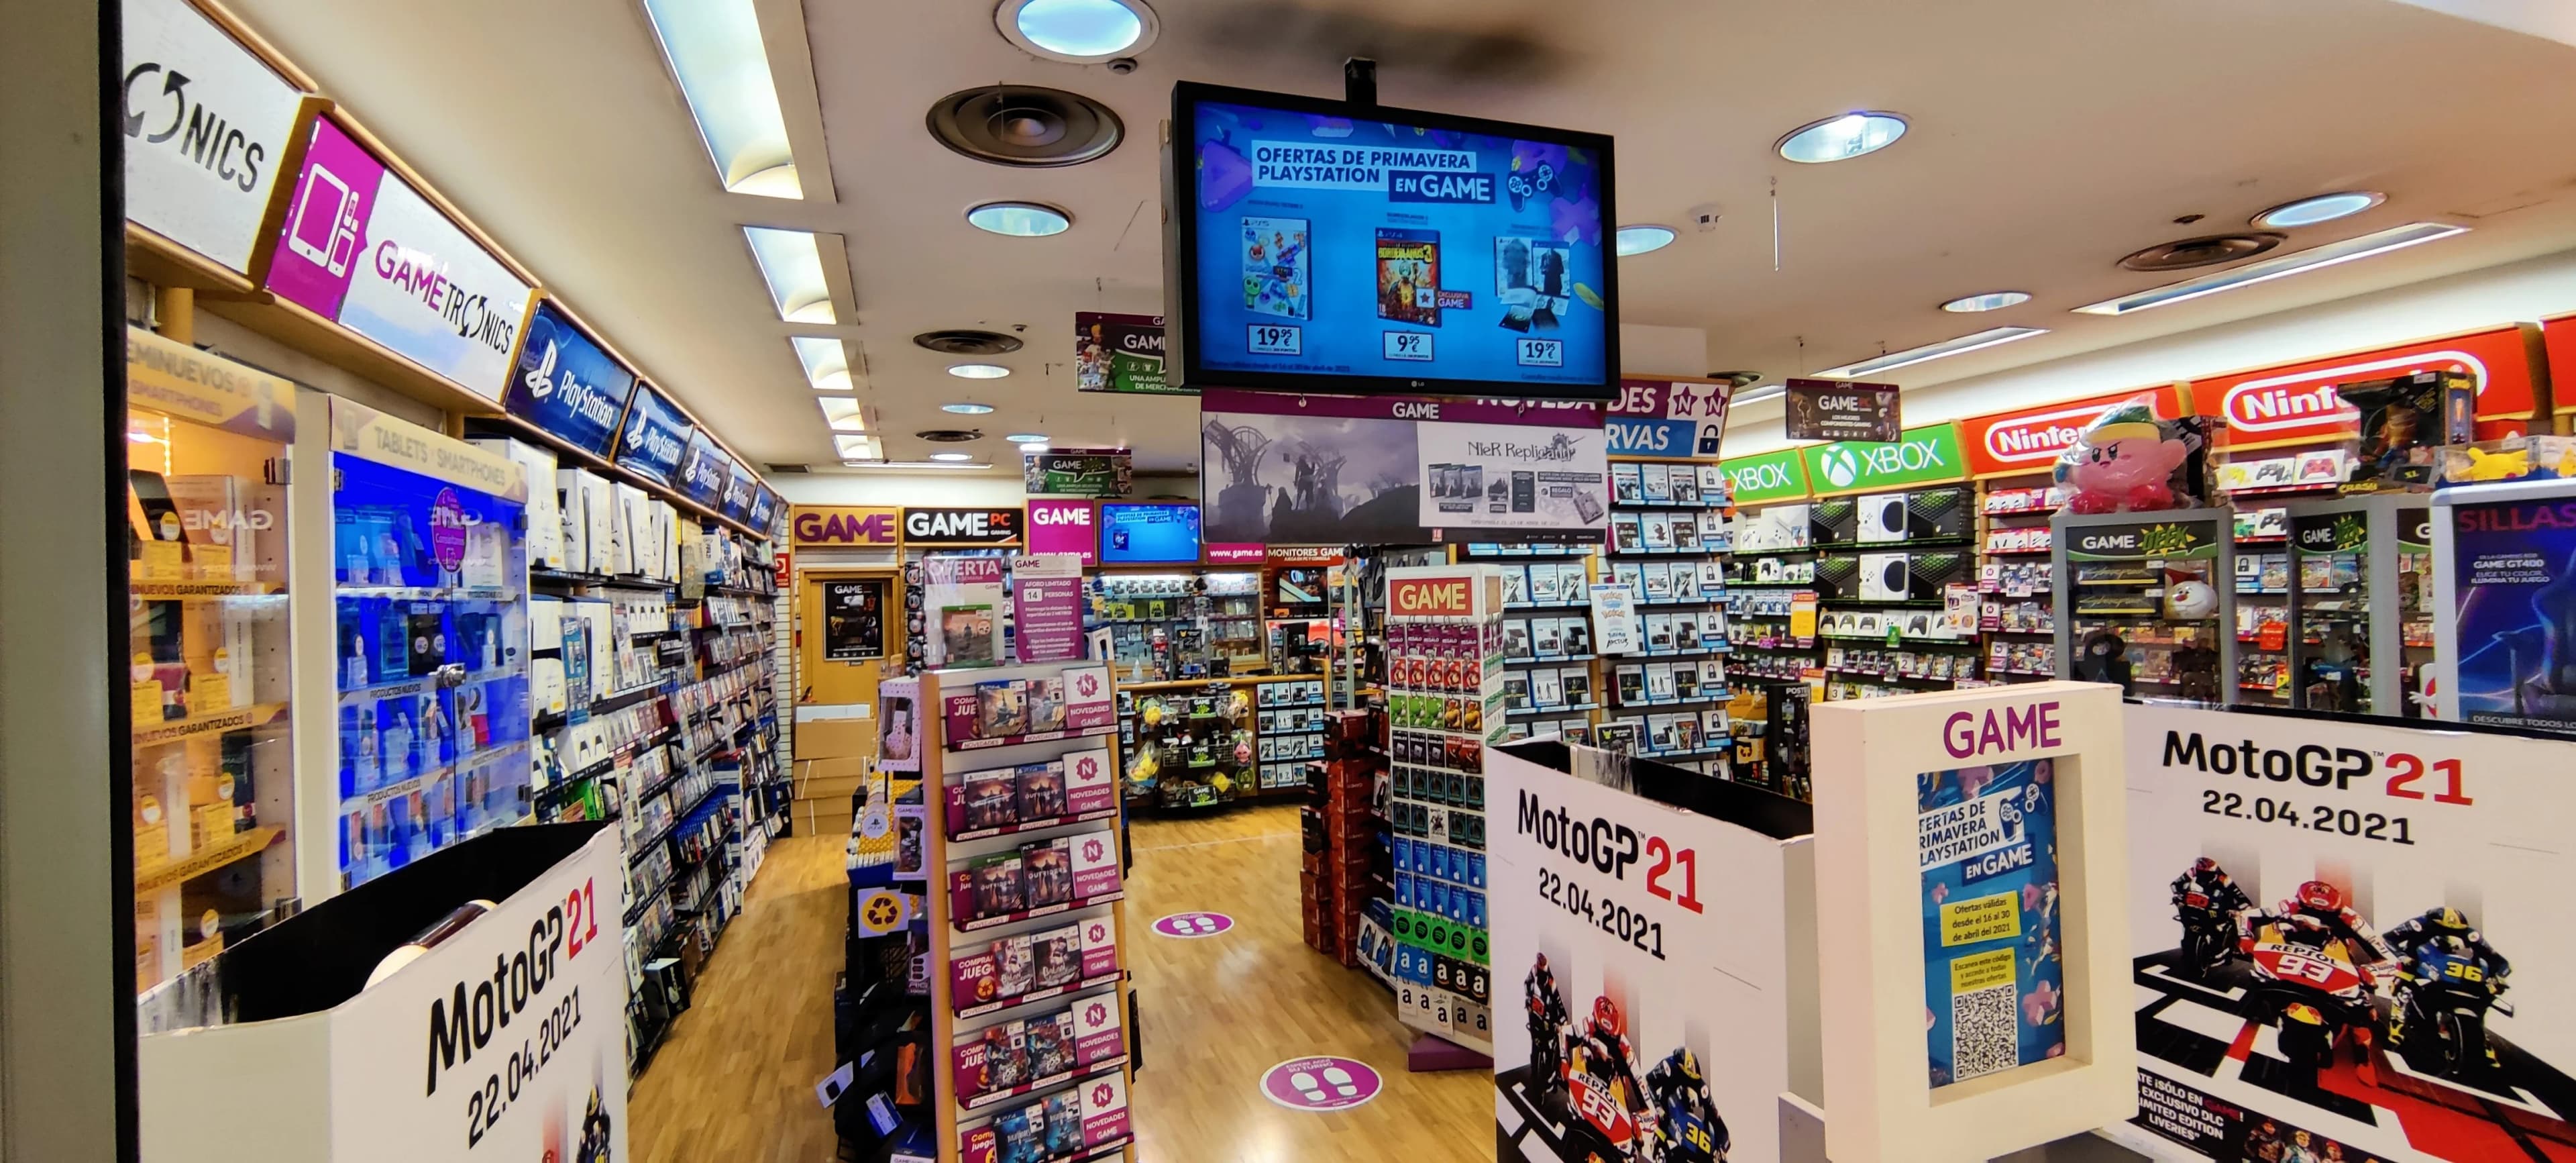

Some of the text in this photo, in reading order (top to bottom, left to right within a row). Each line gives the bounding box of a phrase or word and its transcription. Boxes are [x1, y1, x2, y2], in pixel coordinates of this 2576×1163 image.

[1256, 147, 1471, 168] OFERTAS DE PRIMAVERA
[1258, 165, 1380, 183] PLAYSTATION
[1395, 174, 1491, 201] EN GAME
[1438, 299, 1464, 308] GAME
[1129, 374, 1145, 383] UNA
[557, 370, 613, 428] PlayStation
[1818, 395, 1858, 411] GAME
[1392, 402, 1440, 419] GAME
[645, 427, 680, 466] PlayStation
[1998, 425, 2088, 453] Ninte
[374, 425, 506, 488] TABLETS SMARTPHONES
[1467, 442, 1502, 458] NieR
[1860, 438, 1945, 476] XBOX
[1053, 460, 1082, 470] GAME
[697, 464, 721, 497] PlayStation
[1731, 462, 1792, 493] XBOX
[907, 513, 1011, 536] GAME PC
[1033, 508, 1091, 525] GAME
[795, 513, 896, 543] GAME
[2302, 527, 2332, 544] GAME
[2082, 535, 2135, 550] GAME
[1210, 548, 1263, 558] www.game.es
[1268, 548, 1318, 557] MONITORES
[1015, 560, 1040, 568] GAME
[2473, 560, 2506, 568] GAME
[176, 584, 241, 595] GARANTIZADOS
[835, 585, 863, 595] GAME
[1028, 591, 1038, 599] 14
[1399, 583, 1466, 611] GAME
[954, 705, 977, 716] JUE
[1070, 705, 1110, 716] NOVEDADES
[178, 715, 244, 736] GARANTIZADOS
[1081, 717, 1102, 727] GAME
[1943, 701, 2062, 759] GAME
[2473, 715, 2576, 731] DESCUBRE TODOS LO
[963, 739, 1000, 749] NOVEDADES
[1026, 732, 1060, 742] NOVEDADES
[2385, 752, 2474, 807] 21
[1070, 788, 1110, 799] NOVEDADES
[1081, 801, 1102, 810] GAME
[1970, 800, 1986, 817] DE
[2202, 789, 2416, 846] 22.04.2021
[1966, 844, 2033, 879] EN GAME
[1077, 869, 1116, 882] NOVEDADES
[1646, 836, 1704, 915] 21
[1087, 882, 1108, 893] GAME
[969, 893, 1121, 929] NOVEDADES NOVEDADES NOVEDADES
[1538, 866, 1666, 961] 22.04.2021
[1954, 898, 2008, 915] Ofertas válidas
[566, 875, 598, 962] 21
[1952, 909, 2010, 928] desde el 16 al 30
[1953, 923, 2010, 942] de abril del 2021
[1083, 949, 1114, 961] NOVEDADES
[1954, 954, 2011, 972] Escanea este código
[2270, 943, 2338, 967] REPSOL
[959, 966, 994, 980] JUEG
[1090, 960, 1110, 971] GAME
[2277, 954, 2332, 984] 93
[2444, 961, 2482, 981] 36
[1986, 973, 2007, 983] ofertas
[961, 1004, 998, 1017] NOVEDADES
[1079, 1032, 1119, 1049] NOVEDADES
[1089, 1046, 1112, 1060] GAME
[468, 984, 582, 1151] 22.04.2021
[1578, 1073, 1619, 1111] REPSOL
[2187, 1093, 2203, 1105] EN
[1581, 1086, 1617, 1131] 93
[2141, 1087, 2224, 1127] EXCLUSIVO DLC
[1086, 1111, 1125, 1129] NOVEDADES
[2178, 1113, 2224, 1140] EDITION
[1096, 1126, 1118, 1140] GAME
[1685, 1121, 1712, 1155] 36
